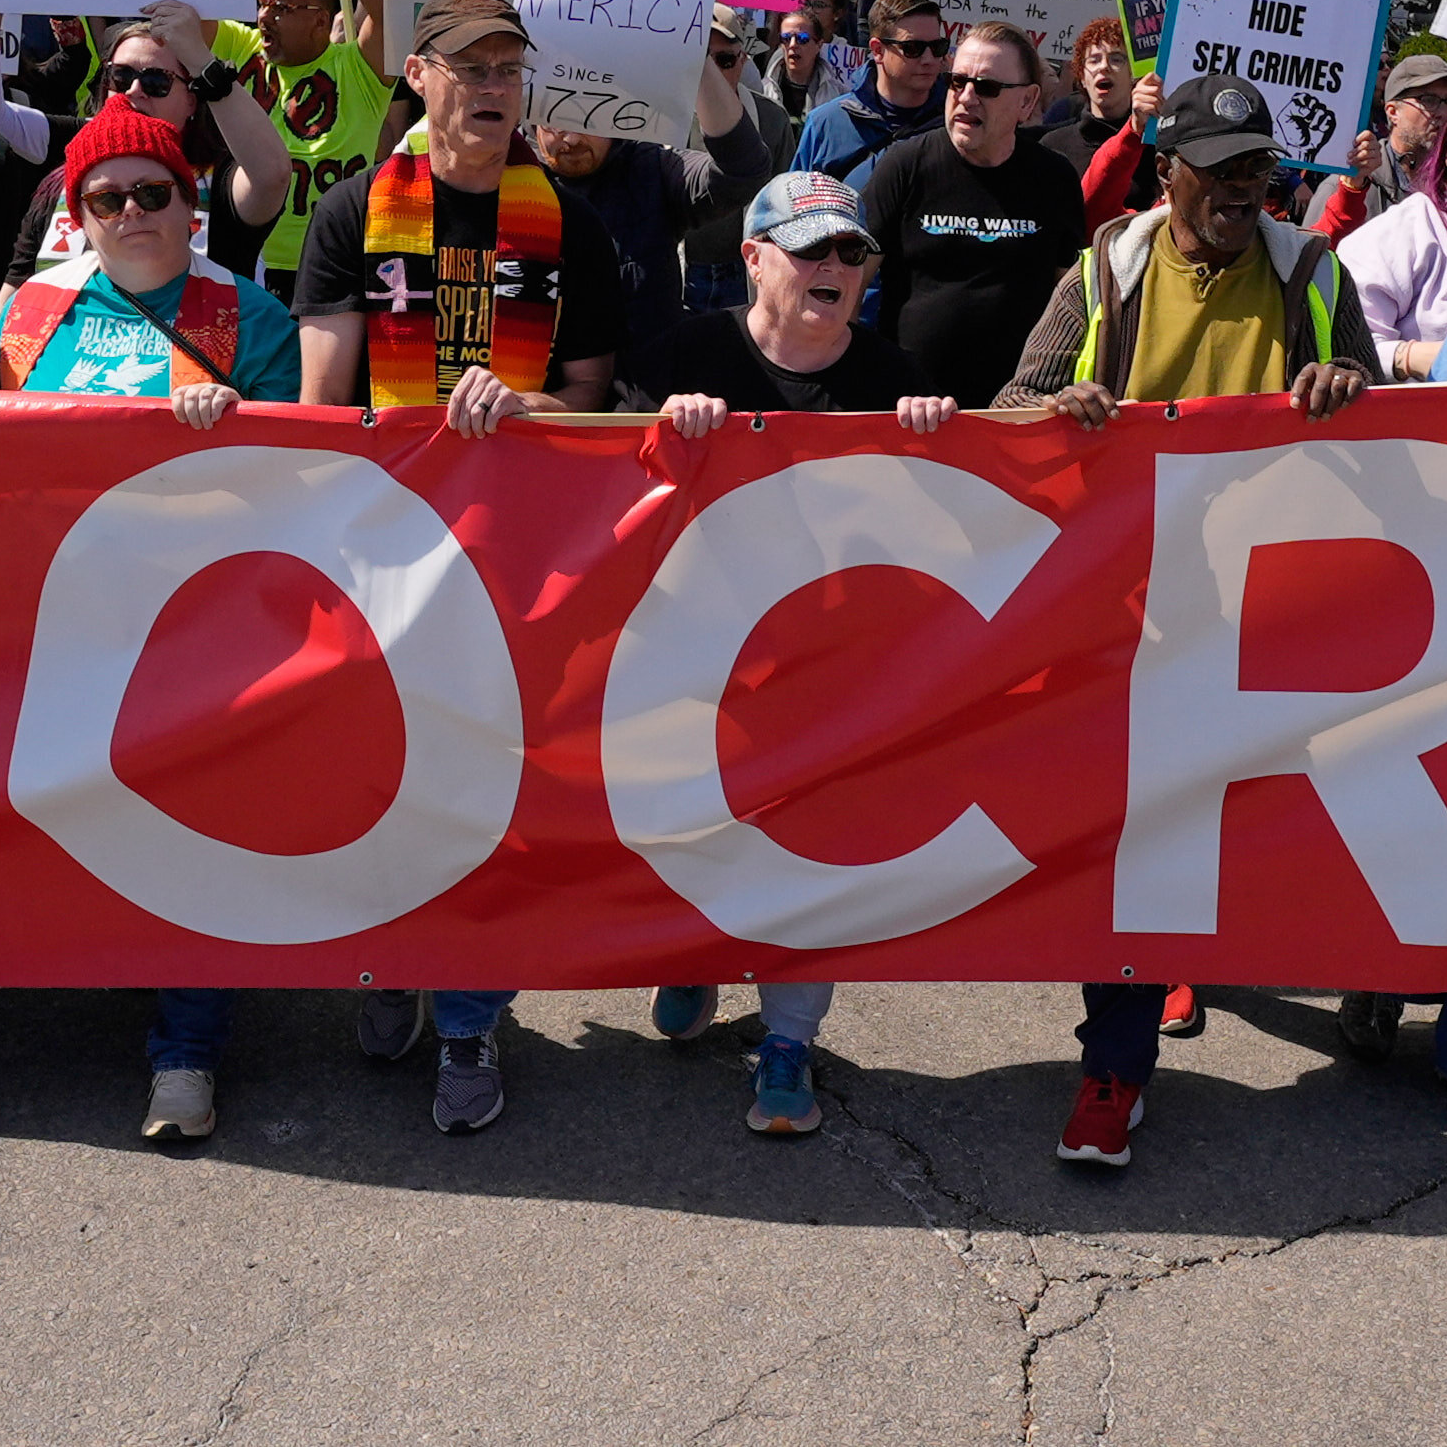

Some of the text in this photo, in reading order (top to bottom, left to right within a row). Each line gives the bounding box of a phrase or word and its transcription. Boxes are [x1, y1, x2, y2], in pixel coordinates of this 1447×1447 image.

[1025, 4, 1048, 20] the
[1135, 0, 1150, 18] IF
[1058, 25, 1074, 40] of
[1052, 40, 1074, 56] the
[553, 64, 615, 84] SINCE
[1193, 40, 1344, 94] SEX CRIMES
[526, 83, 650, 131] 1776
[923, 215, 1036, 232] LIVING WATER
[438, 247, 477, 283] RAISE
